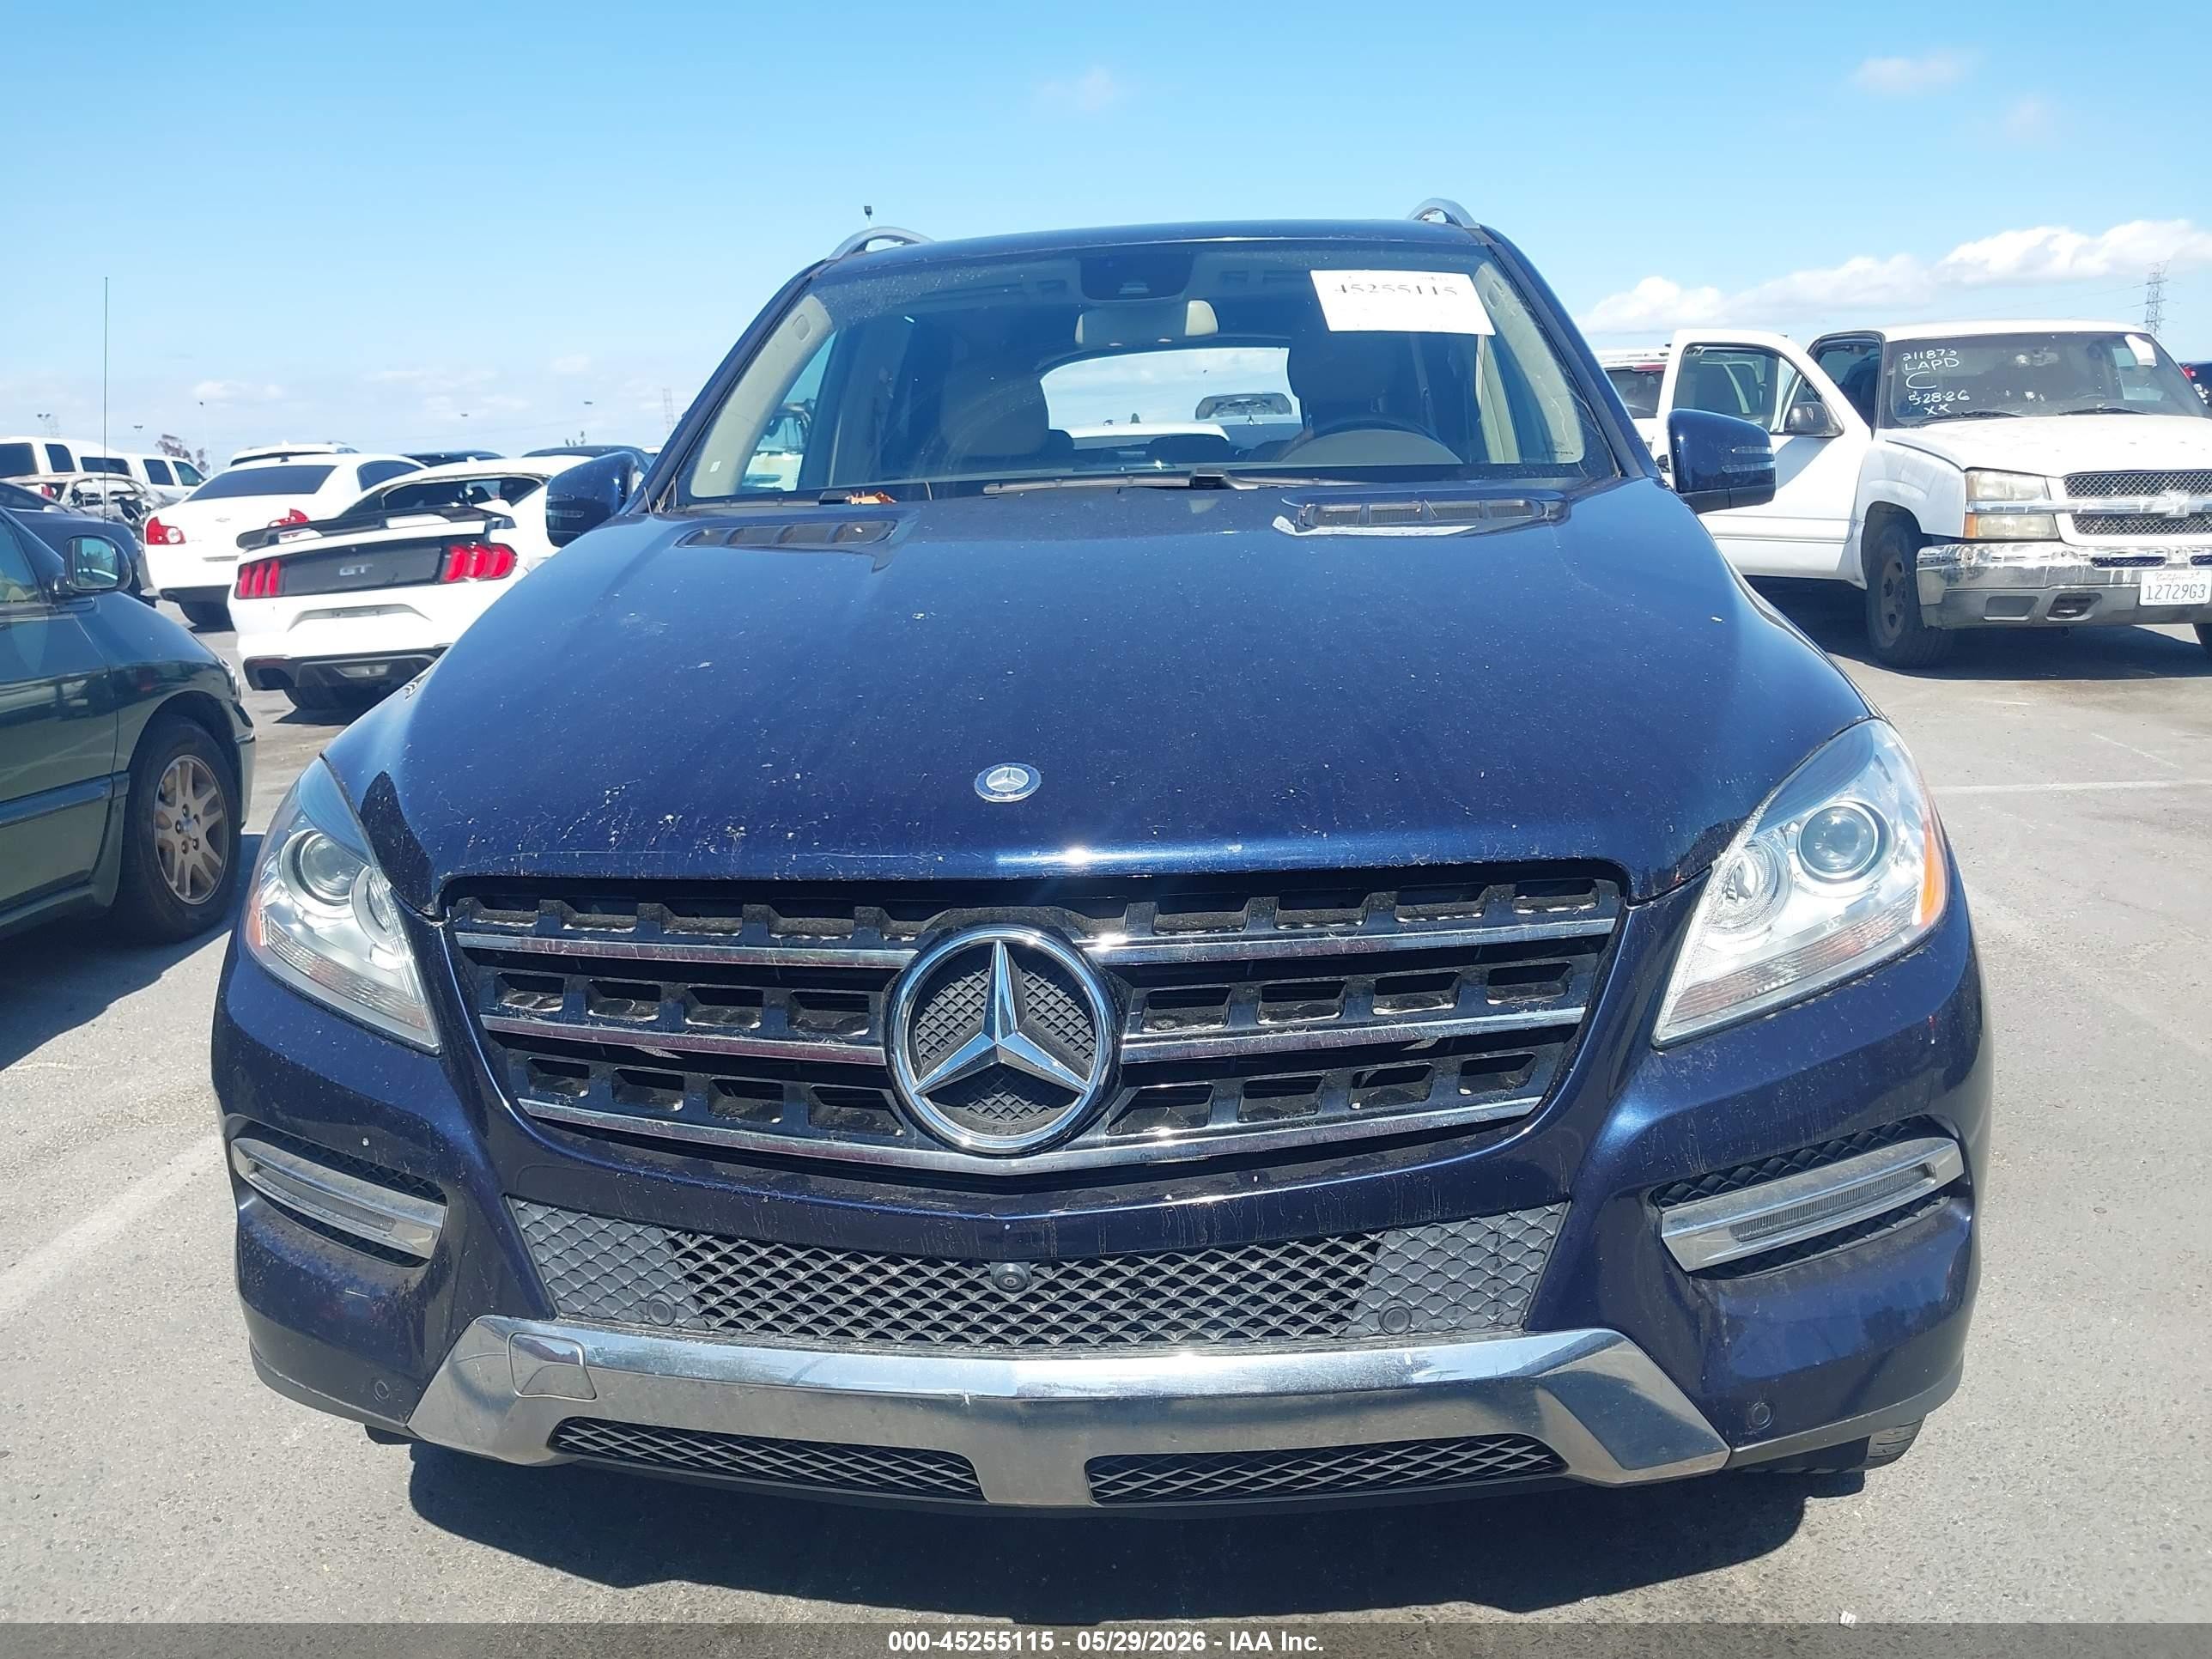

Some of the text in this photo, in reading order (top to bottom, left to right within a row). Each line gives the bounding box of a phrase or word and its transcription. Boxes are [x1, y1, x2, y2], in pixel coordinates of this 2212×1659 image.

[1905, 357, 1960, 370] LAPD
[1905, 371, 1937, 389] C
[339, 562, 374, 576] GT
[2145, 583, 2206, 600] 12729G3
